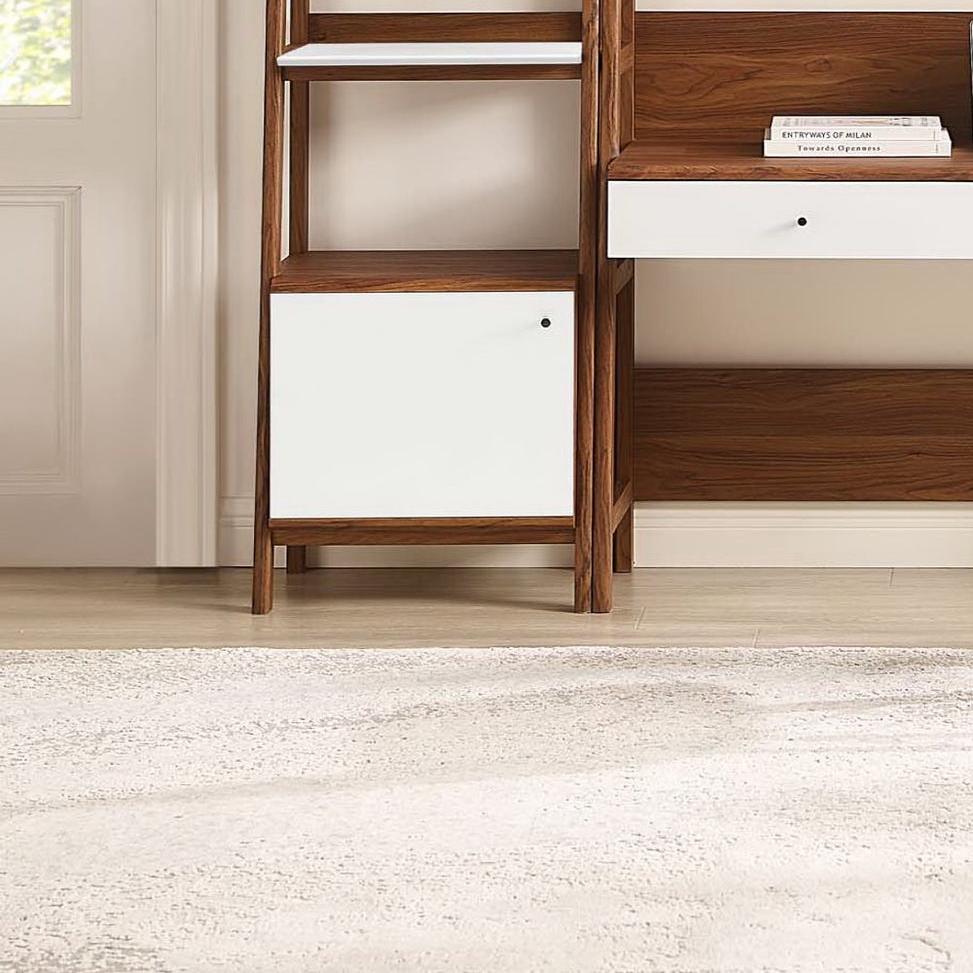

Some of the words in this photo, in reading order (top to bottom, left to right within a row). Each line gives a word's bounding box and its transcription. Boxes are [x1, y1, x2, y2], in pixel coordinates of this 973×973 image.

[781, 131, 831, 139] ENTRYWAYS
[832, 131, 844, 139] OF
[845, 131, 872, 139] MILAN
[797, 144, 835, 152] Towards
[837, 144, 881, 153] Openness
